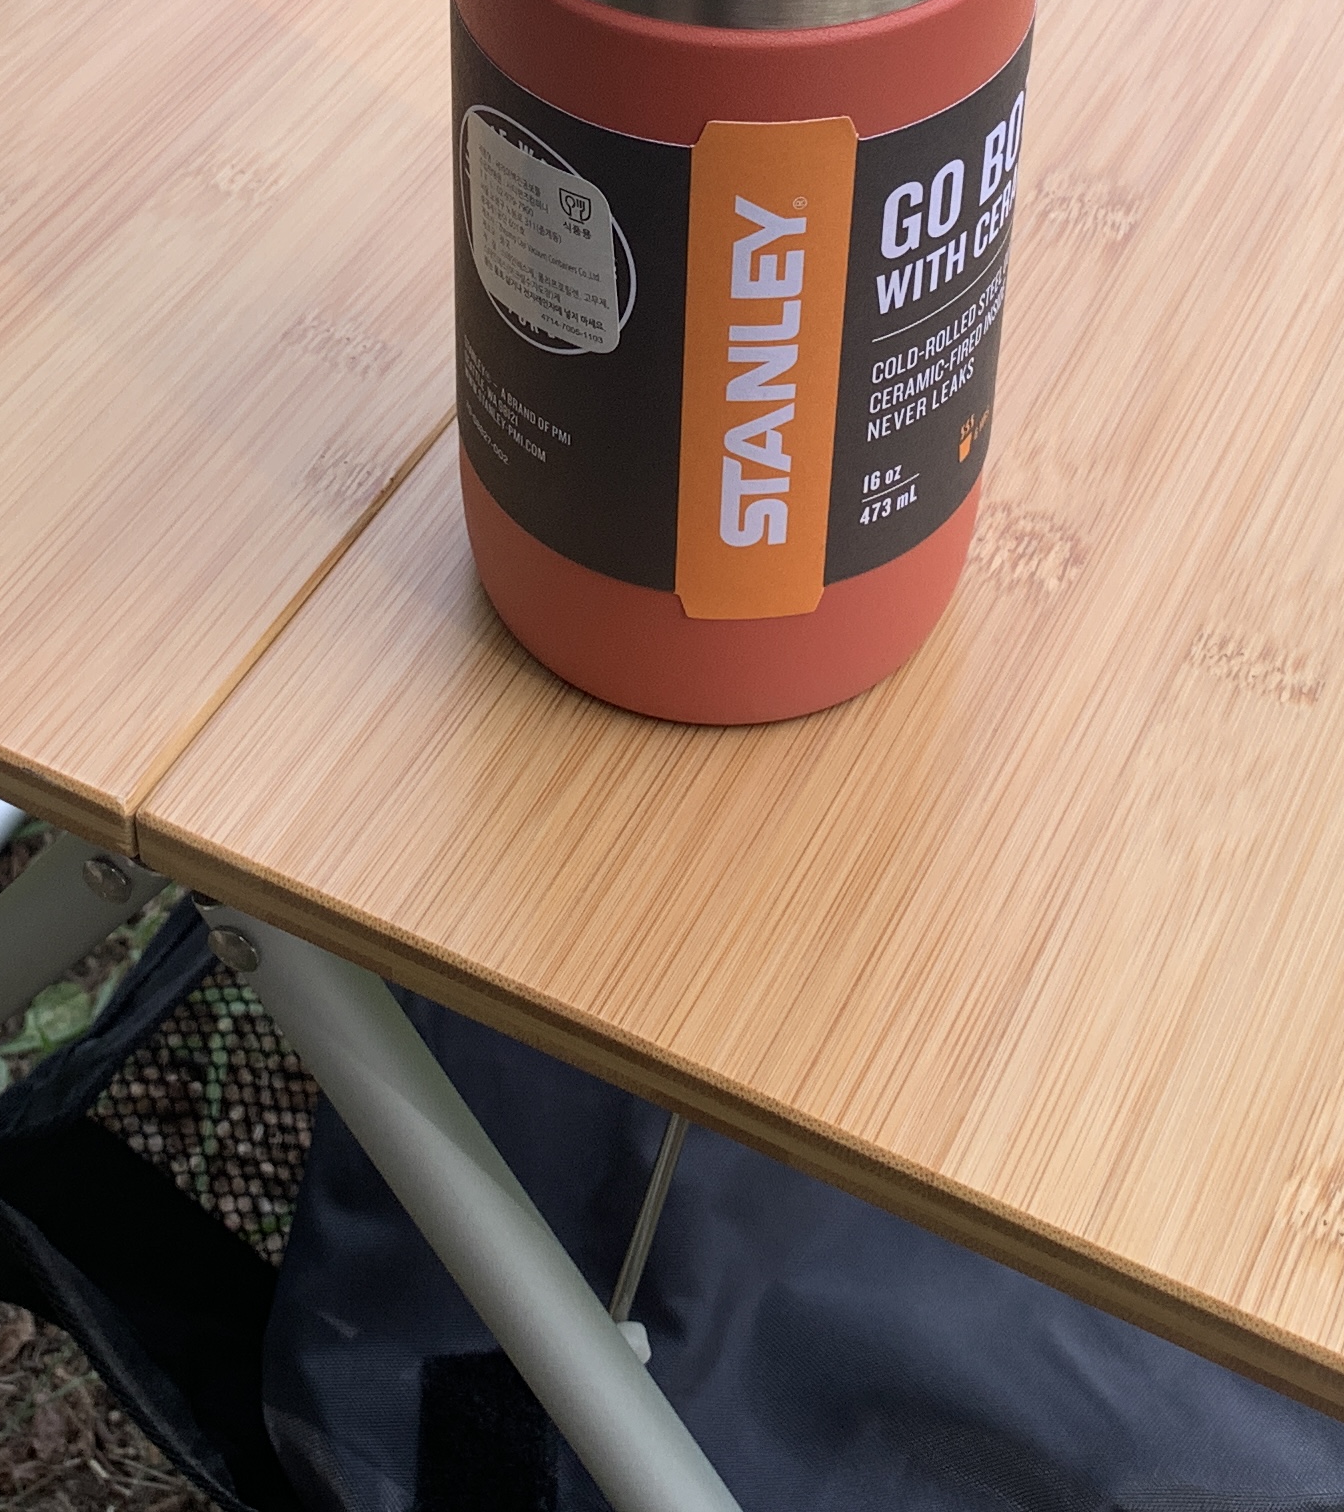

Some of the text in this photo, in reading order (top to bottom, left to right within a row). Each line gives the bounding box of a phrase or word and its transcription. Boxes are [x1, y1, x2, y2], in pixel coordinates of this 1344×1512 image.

[880, 158, 965, 259] GO
[876, 231, 968, 315] WITH
[869, 322, 983, 414] CERAMIC-FIRED
[871, 303, 977, 384] COLD-ROLLED
[507, 392, 537, 425] BRAND
[537, 416, 550, 433] OF
[551, 425, 572, 446] PMI
[866, 396, 927, 442] NEVER
[931, 356, 975, 410] LEAKS
[859, 483, 918, 526] 473 mL
[862, 464, 903, 494] 16 oz
